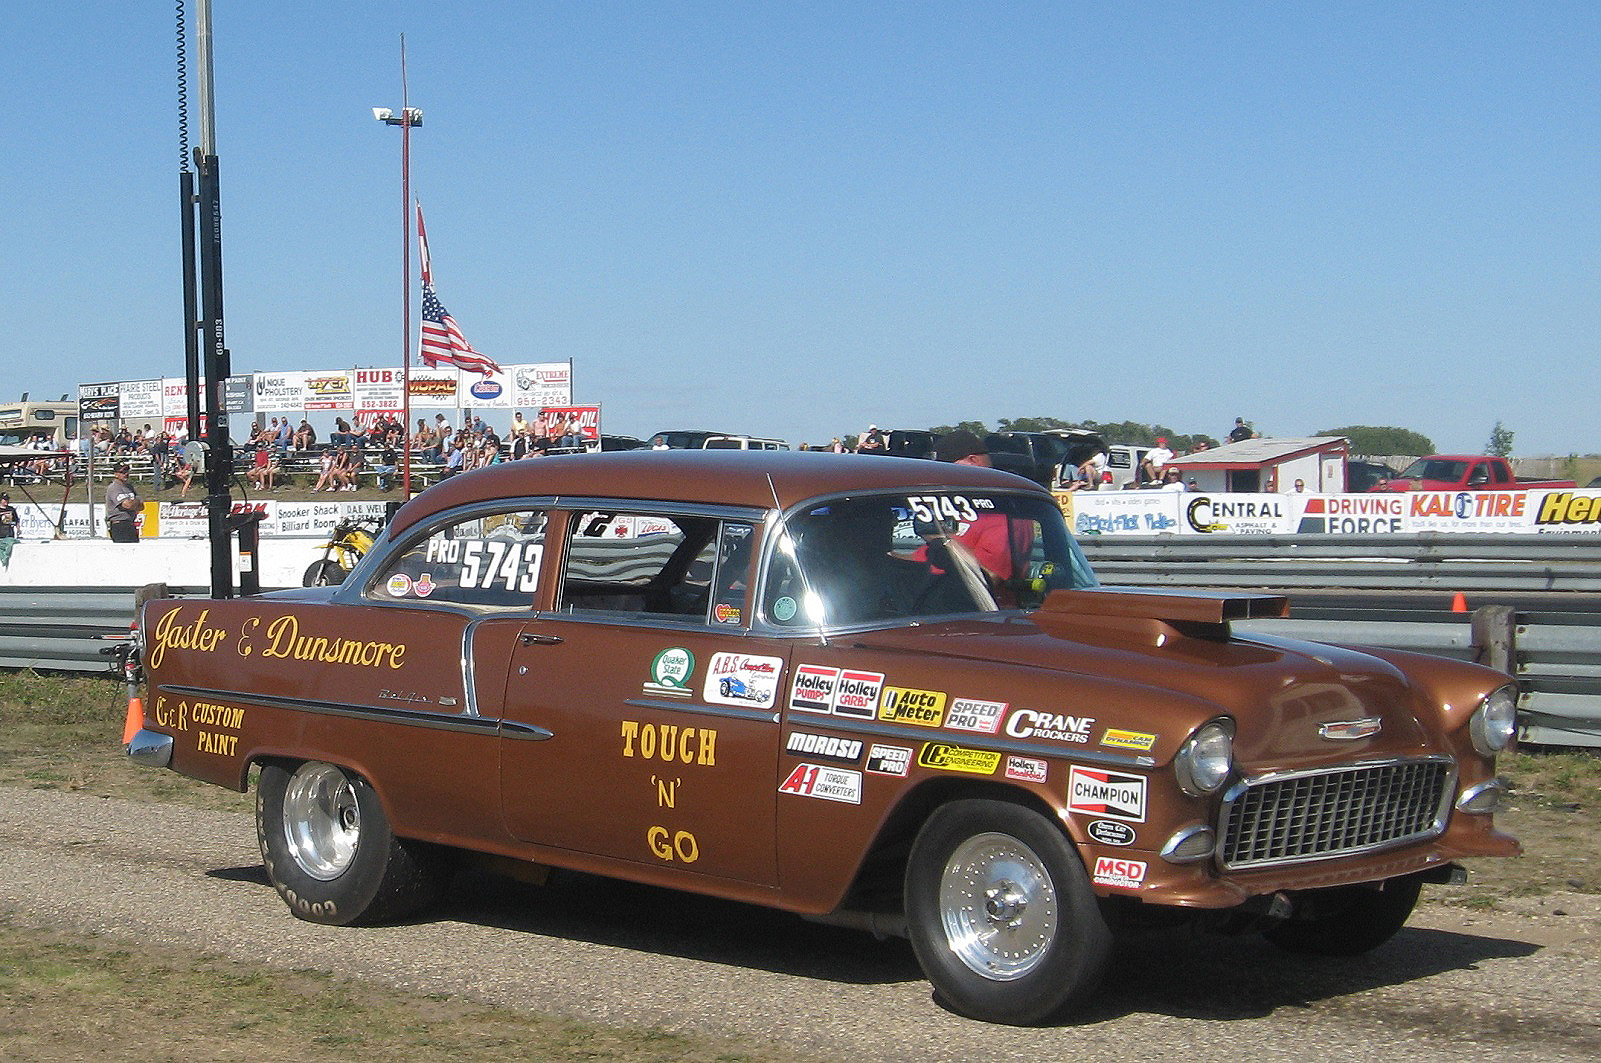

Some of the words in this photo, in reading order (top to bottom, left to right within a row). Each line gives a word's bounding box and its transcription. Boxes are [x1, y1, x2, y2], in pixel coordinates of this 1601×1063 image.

[356, 370, 393, 383] HUB
[142, 381, 161, 392] STEEL
[579, 411, 597, 428] OIL
[278, 508, 310, 520] Snooker
[313, 505, 339, 516] Shack
[907, 495, 979, 523] 5743
[972, 498, 996, 510] PRO
[1329, 499, 1402, 514] DRIVING
[1410, 494, 1454, 517] KAL
[1475, 493, 1527, 517] TIRE
[1187, 497, 1283, 533] CENTRAL
[281, 520, 310, 532] Billiard
[313, 519, 337, 529] Room
[1329, 517, 1402, 533] FORCE
[426, 539, 460, 563] PRO
[459, 540, 544, 593] 5743
[150, 605, 226, 669] Jaster
[262, 614, 406, 669] Dunsmore
[662, 654, 687, 666] Quaker
[663, 664, 682, 674] State
[795, 673, 834, 696] Holley
[838, 679, 878, 702] Holley
[795, 688, 824, 702] PUMPS
[839, 695, 870, 708] CARBS
[900, 691, 937, 707] Auto
[192, 702, 245, 729] CUSTOM
[894, 703, 941, 721] Meter
[952, 701, 998, 716] SPEED
[947, 713, 978, 728] PRO
[1005, 708, 1096, 739] CRANE
[197, 731, 239, 757] PAINT
[621, 720, 718, 767] TOUCH
[1033, 728, 1089, 744] ROCKERS
[786, 732, 863, 759] MOROSO
[870, 746, 909, 761] SPEED
[944, 756, 995, 768] ENGINEERING
[948, 749, 998, 760] COMPETITION
[879, 759, 905, 773] PRO
[1009, 758, 1035, 772] Holley
[824, 772, 850, 785] TORQUE
[815, 783, 857, 798] CONVERTERS
[1074, 782, 1138, 805] CHAMPION
[647, 825, 700, 864] GO
[1096, 859, 1142, 879] MSD
